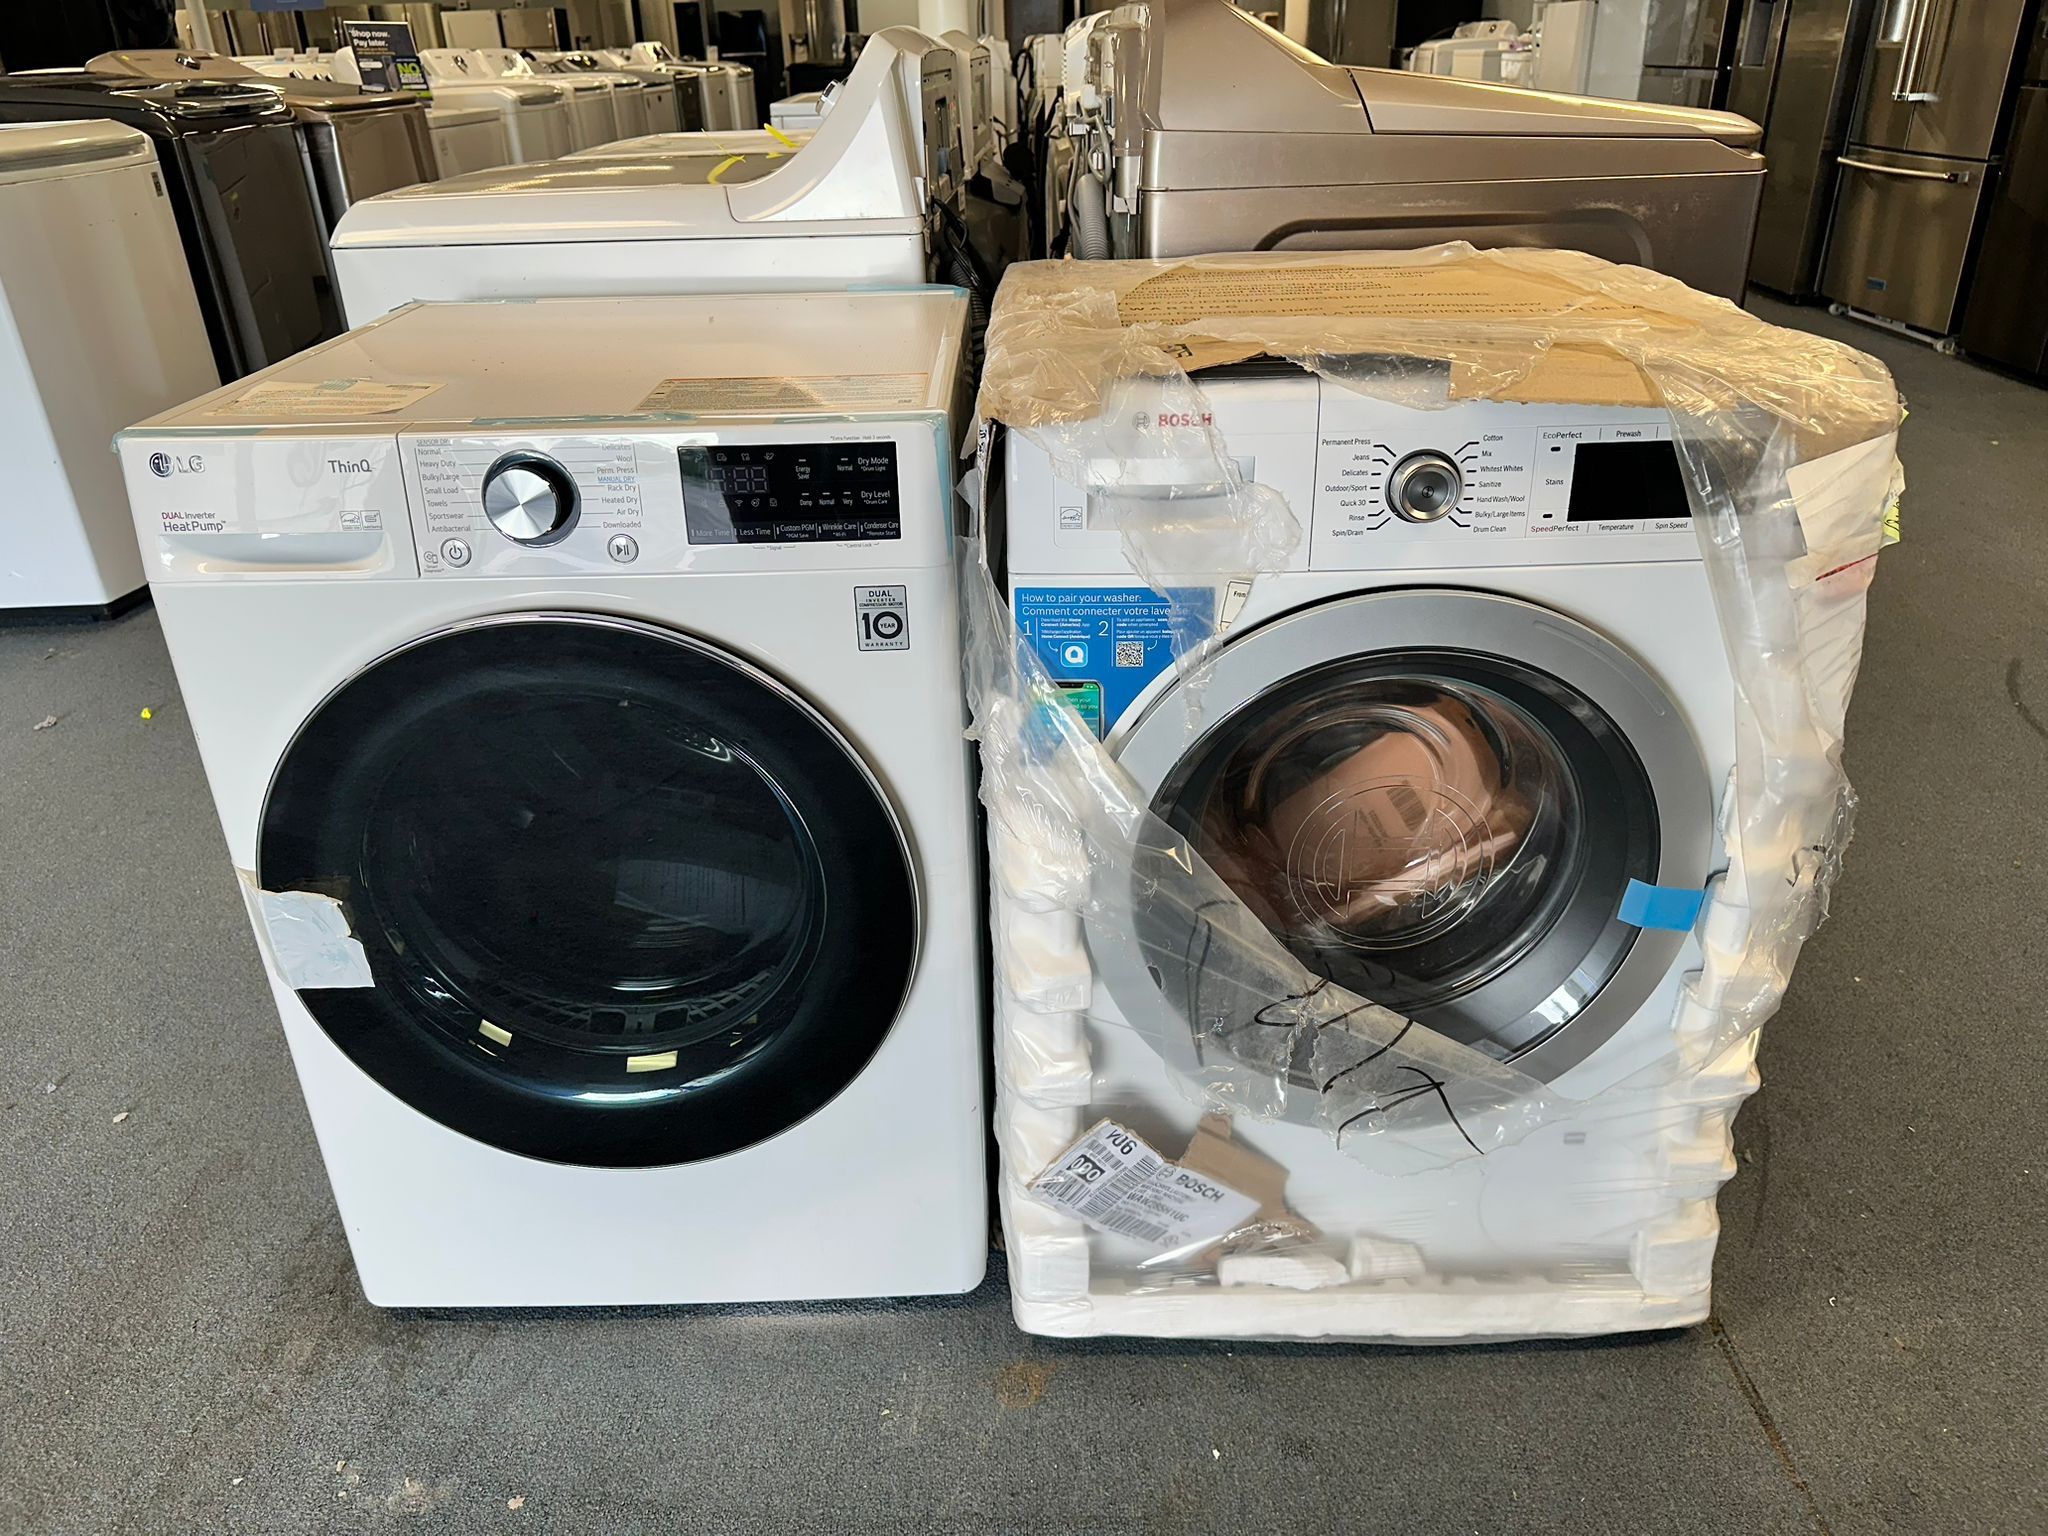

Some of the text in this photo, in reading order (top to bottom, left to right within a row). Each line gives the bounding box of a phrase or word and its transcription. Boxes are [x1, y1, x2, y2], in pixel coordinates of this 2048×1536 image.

[351, 29, 371, 39] Shop
[354, 39, 367, 48] Pay
[396, 63, 420, 74] NO
[1542, 431, 1583, 440] EcoPerfect
[1616, 430, 1642, 438] Prewash
[1321, 438, 1353, 447] Permanent
[176, 455, 205, 473] LG
[328, 459, 372, 473] ThinQ
[419, 460, 456, 469] Heavy Duty
[857, 457, 870, 466] Dry
[617, 466, 635, 474] Press
[1342, 469, 1368, 477] Delicates
[422, 474, 460, 482] Bulky/Large
[1545, 478, 1564, 486] Stains
[624, 483, 637, 493] Dry
[1325, 484, 1367, 492] Outdoor/Sport
[861, 490, 891, 499] Dry Level
[626, 496, 638, 505] Dry
[161, 512, 184, 520] DUAL
[429, 512, 464, 520] Sportswear
[627, 508, 640, 518] Dry
[1475, 510, 1509, 519] Bulky/Large
[431, 525, 471, 533] Antibacterial
[603, 521, 642, 529] Downloaded
[780, 524, 801, 532] Custom
[888, 521, 899, 529] Care
[1531, 524, 1579, 533] SpeedPerfect
[1598, 523, 1634, 532] Temperature
[1655, 521, 1688, 530] Spin Speed
[696, 529, 730, 537] More Time
[740, 528, 754, 536] Less
[1332, 529, 1364, 537] Spin/Drain
[1021, 593, 1142, 604] How to pair your washer:
[1022, 607, 1071, 616] Comment
[1072, 607, 1122, 616] connecter
[1123, 607, 1149, 616] votre
[862, 611, 903, 639] 10
[1023, 620, 1033, 636] 1
[1098, 620, 1109, 636] 2
[1175, 1174, 1225, 1202] BOSCH
